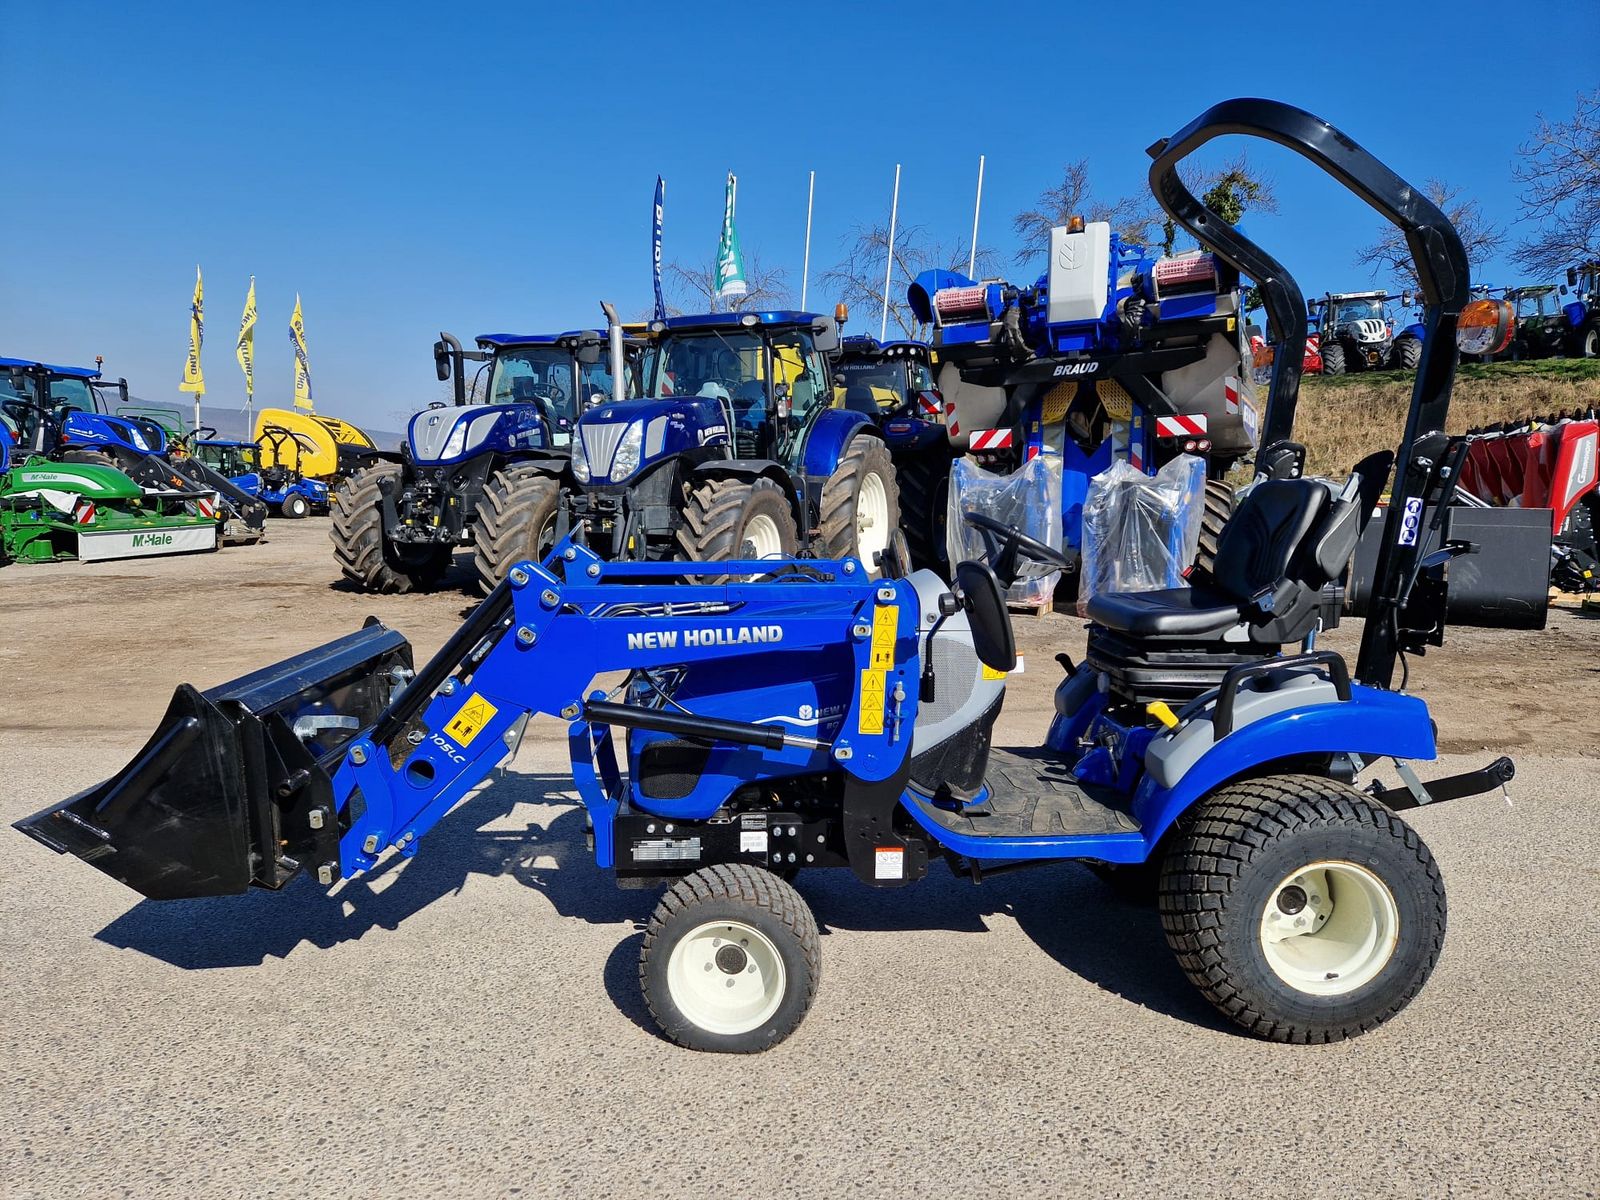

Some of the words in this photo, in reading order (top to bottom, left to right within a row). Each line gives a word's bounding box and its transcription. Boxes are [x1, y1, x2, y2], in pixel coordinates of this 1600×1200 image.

[1053, 362, 1099, 377] BRAUD
[627, 630, 678, 650] NEW
[683, 625, 784, 647] HOLLAND
[429, 733, 466, 764] 105LC
